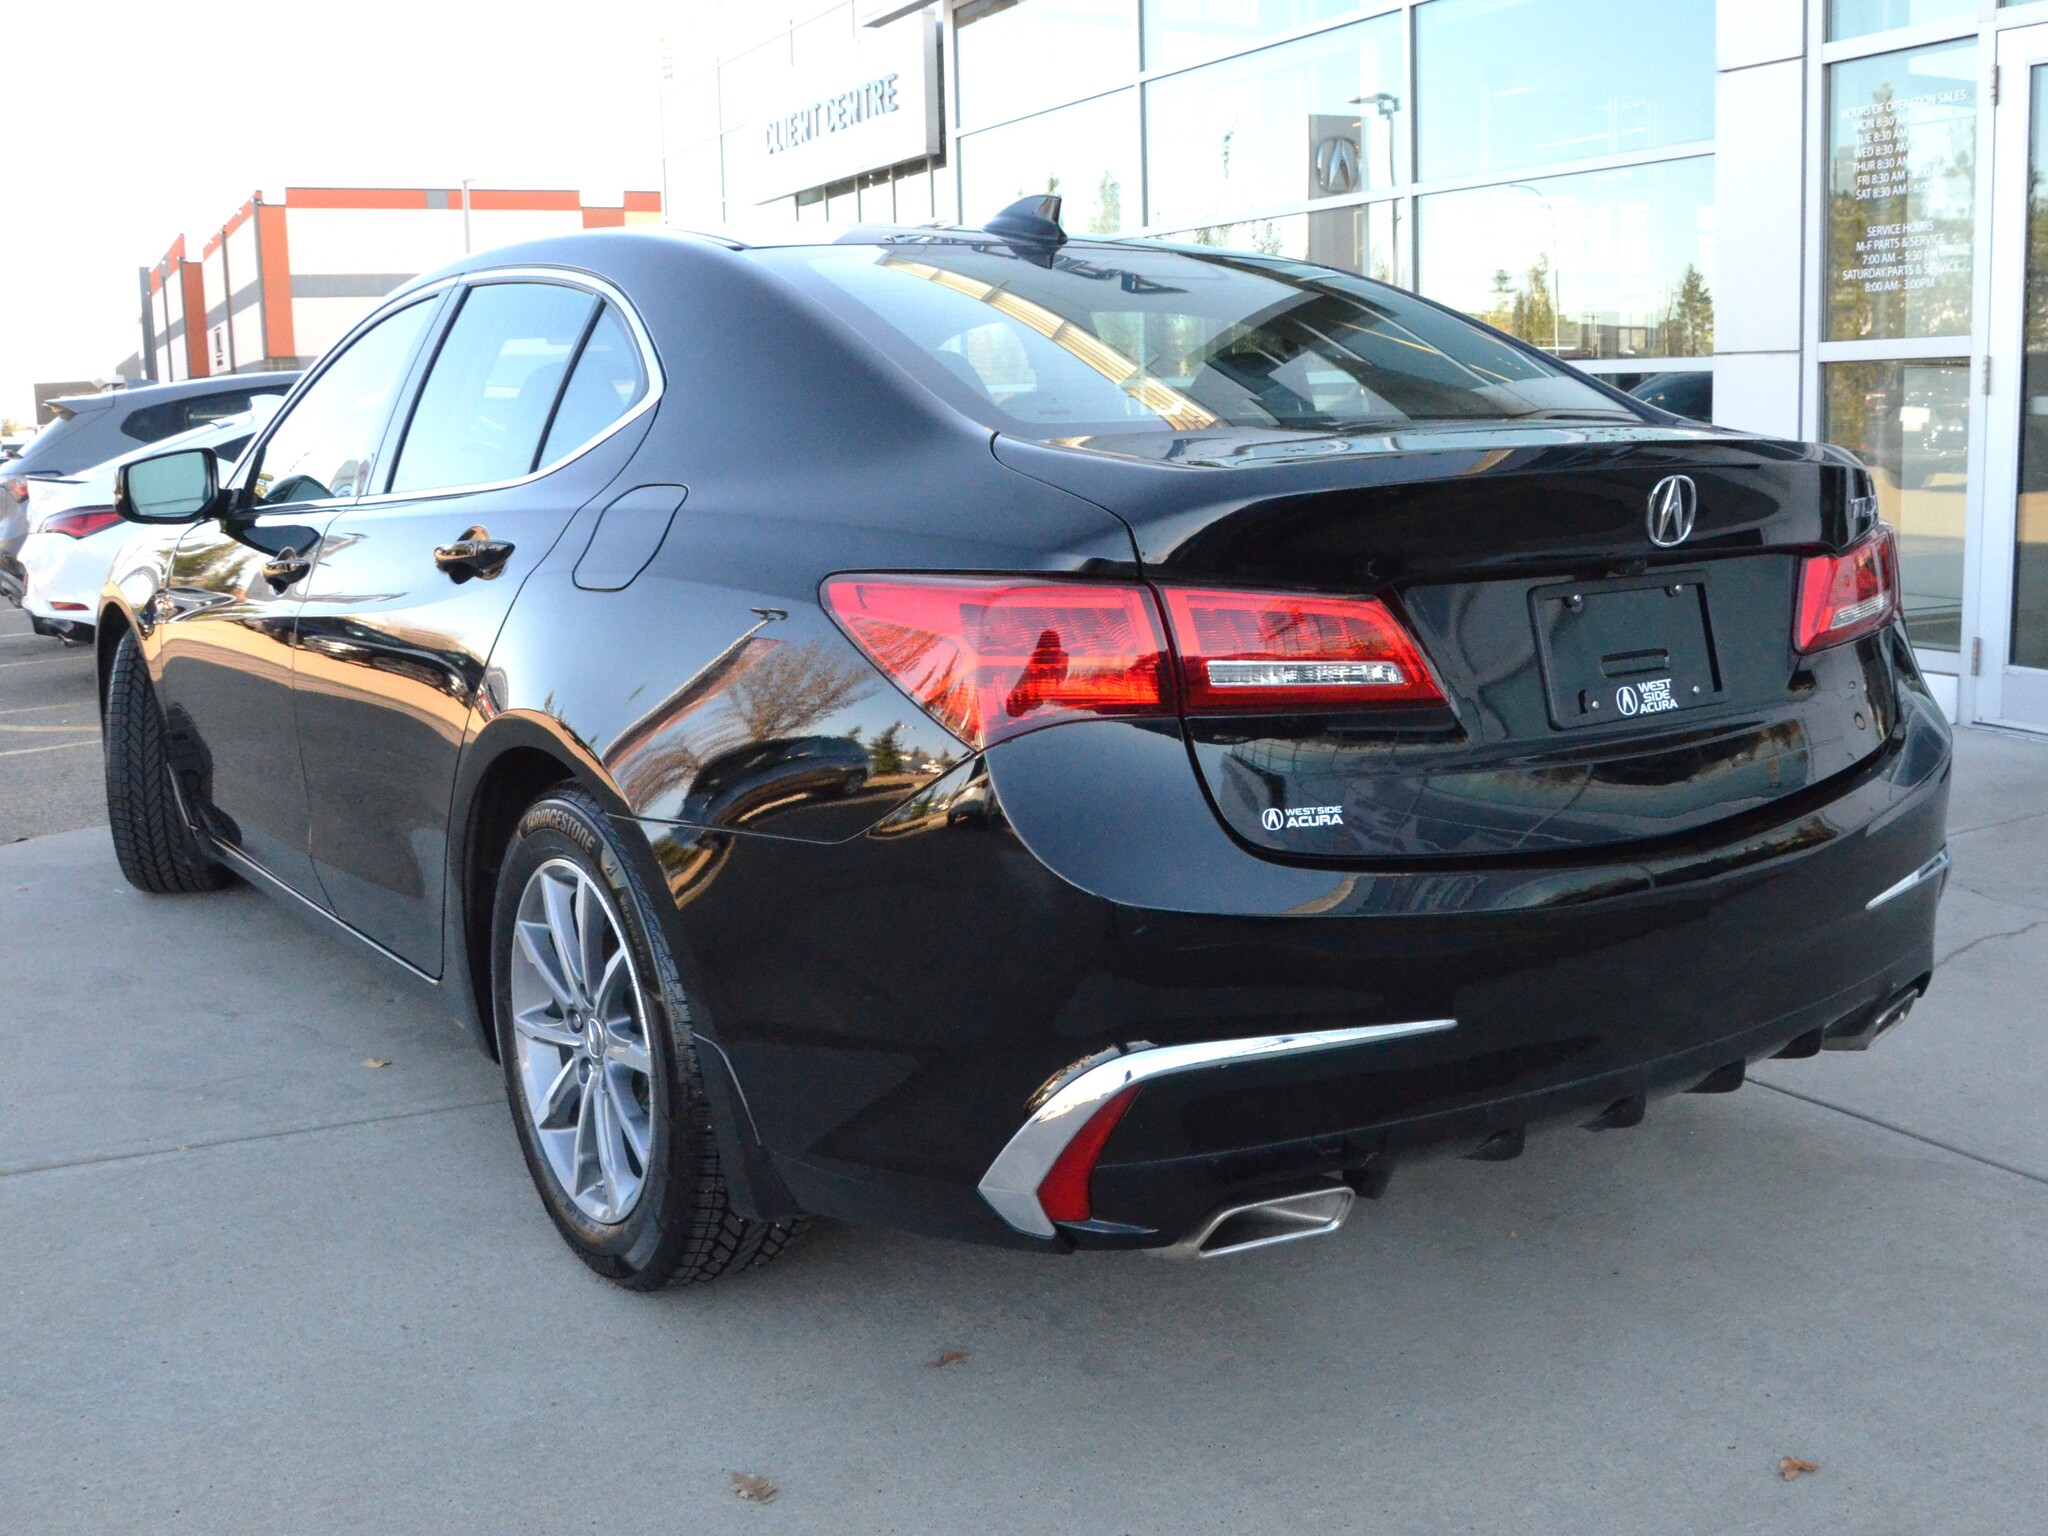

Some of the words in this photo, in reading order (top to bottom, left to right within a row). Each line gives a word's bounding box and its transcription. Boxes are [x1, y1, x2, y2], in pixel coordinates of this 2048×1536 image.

[1841, 104, 1871, 118] HOURS
[1872, 102, 1884, 115] OF
[1886, 94, 1936, 112] OPERATION
[1938, 89, 1967, 103] SALES
[766, 103, 821, 154] CLIENT
[826, 73, 899, 132] CENTRE
[1853, 119, 1875, 131] MON
[1876, 115, 1894, 128] 8:30
[1857, 133, 1872, 144] TUE
[1874, 130, 1892, 142] 8:30
[1893, 127, 1908, 139] AM
[1854, 147, 1874, 159] WED
[1875, 144, 1893, 156] 8:30
[1895, 142, 1908, 153] AM
[1853, 160, 1876, 172] THUR
[1876, 157, 1895, 169] 8:30
[1857, 175, 1870, 186] FRI
[1871, 172, 1890, 184] 8:30
[1891, 170, 1906, 182] AM
[1856, 188, 1872, 200] SAT
[1872, 186, 1891, 198] 8:30
[1892, 183, 1907, 195] AM
[1867, 223, 1901, 238] SERVICE
[1903, 220, 1935, 234] HOURS
[1856, 241, 1872, 252] M-F
[1873, 238, 1900, 250] PARTS
[1901, 236, 1909, 248] &
[1909, 233, 1946, 247] SERVICE
[1863, 254, 1881, 265] 7:00
[1881, 252, 1896, 263] AM
[1904, 250, 1922, 261] 5:30
[1924, 247, 1938, 259] PM
[1842, 266, 1886, 281] SATURDAY
[1887, 264, 1914, 277] PARTS
[1915, 263, 1923, 274] &
[1924, 260, 1961, 274] SERVICE
[1865, 281, 1883, 293] 8:00
[1637, 678, 1672, 693] WEST
[1643, 689, 1671, 703] SIDE
[1640, 698, 1679, 714] ACURA
[1285, 806, 1316, 816] WEST
[1317, 805, 1343, 815] SIDE
[1286, 814, 1344, 828] ACURA
[526, 808, 596, 854] BRIDGESTONE
